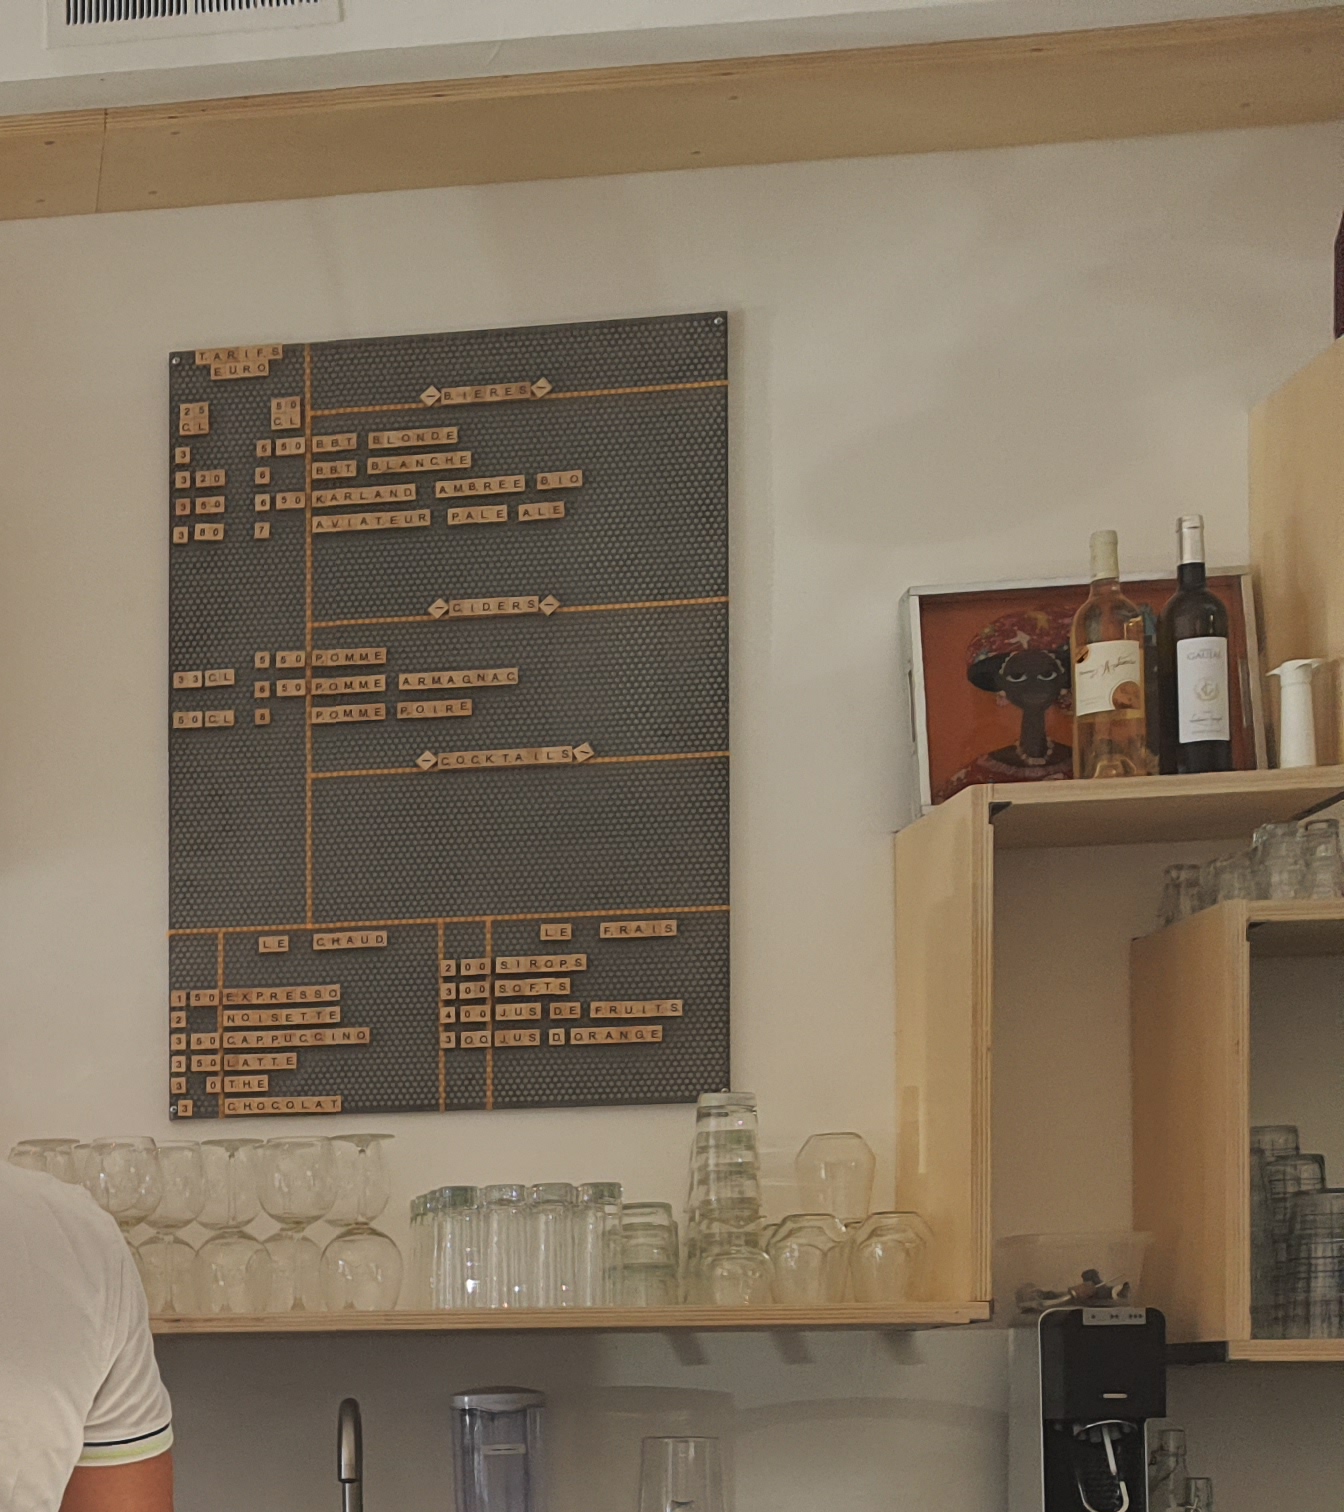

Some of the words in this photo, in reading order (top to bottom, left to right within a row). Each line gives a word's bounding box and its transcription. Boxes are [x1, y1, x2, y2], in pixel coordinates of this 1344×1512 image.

[198, 346, 281, 363] TARIFS
[213, 362, 267, 378] EURO
[443, 384, 529, 401] BIERES
[315, 436, 355, 450] BBT
[371, 429, 456, 446] BLONDE
[315, 462, 354, 477] BBT
[370, 454, 470, 471] BLANCHE
[315, 486, 414, 506] KARLAND
[438, 478, 522, 496] AMBREE
[539, 473, 581, 487] BIO
[315, 512, 428, 531] AVIATEUR
[450, 507, 506, 522] PALE
[521, 504, 563, 517] ALE
[451, 598, 537, 614] CIDERS
[314, 650, 383, 665] POMME
[314, 677, 383, 691] POMME
[401, 670, 517, 687] ARMAGNAC
[314, 706, 383, 721] POMME
[400, 700, 469, 716] POIRE
[440, 748, 570, 767] COCKTAILS
[544, 926, 568, 938] LE
[603, 922, 675, 937] FRAIS
[262, 938, 287, 950] LE
[316, 933, 385, 948] CHAUD
[500, 957, 584, 971] SIROPS
[225, 988, 338, 1002] EXPRESSO
[498, 981, 567, 995] SOFTS
[226, 1010, 338, 1025] NOISETTE
[499, 1006, 538, 1019] JUS
[552, 1005, 579, 1017] DE
[593, 1002, 679, 1016] FRUITS
[226, 1030, 367, 1046] CAPPUCCINO
[498, 1032, 538, 1046] JUS
[573, 1029, 660, 1043] ORANGE
[226, 1055, 295, 1068] LATTE
[228, 1078, 265, 1090] THE
[226, 1097, 340, 1112] CHOCOLAT
